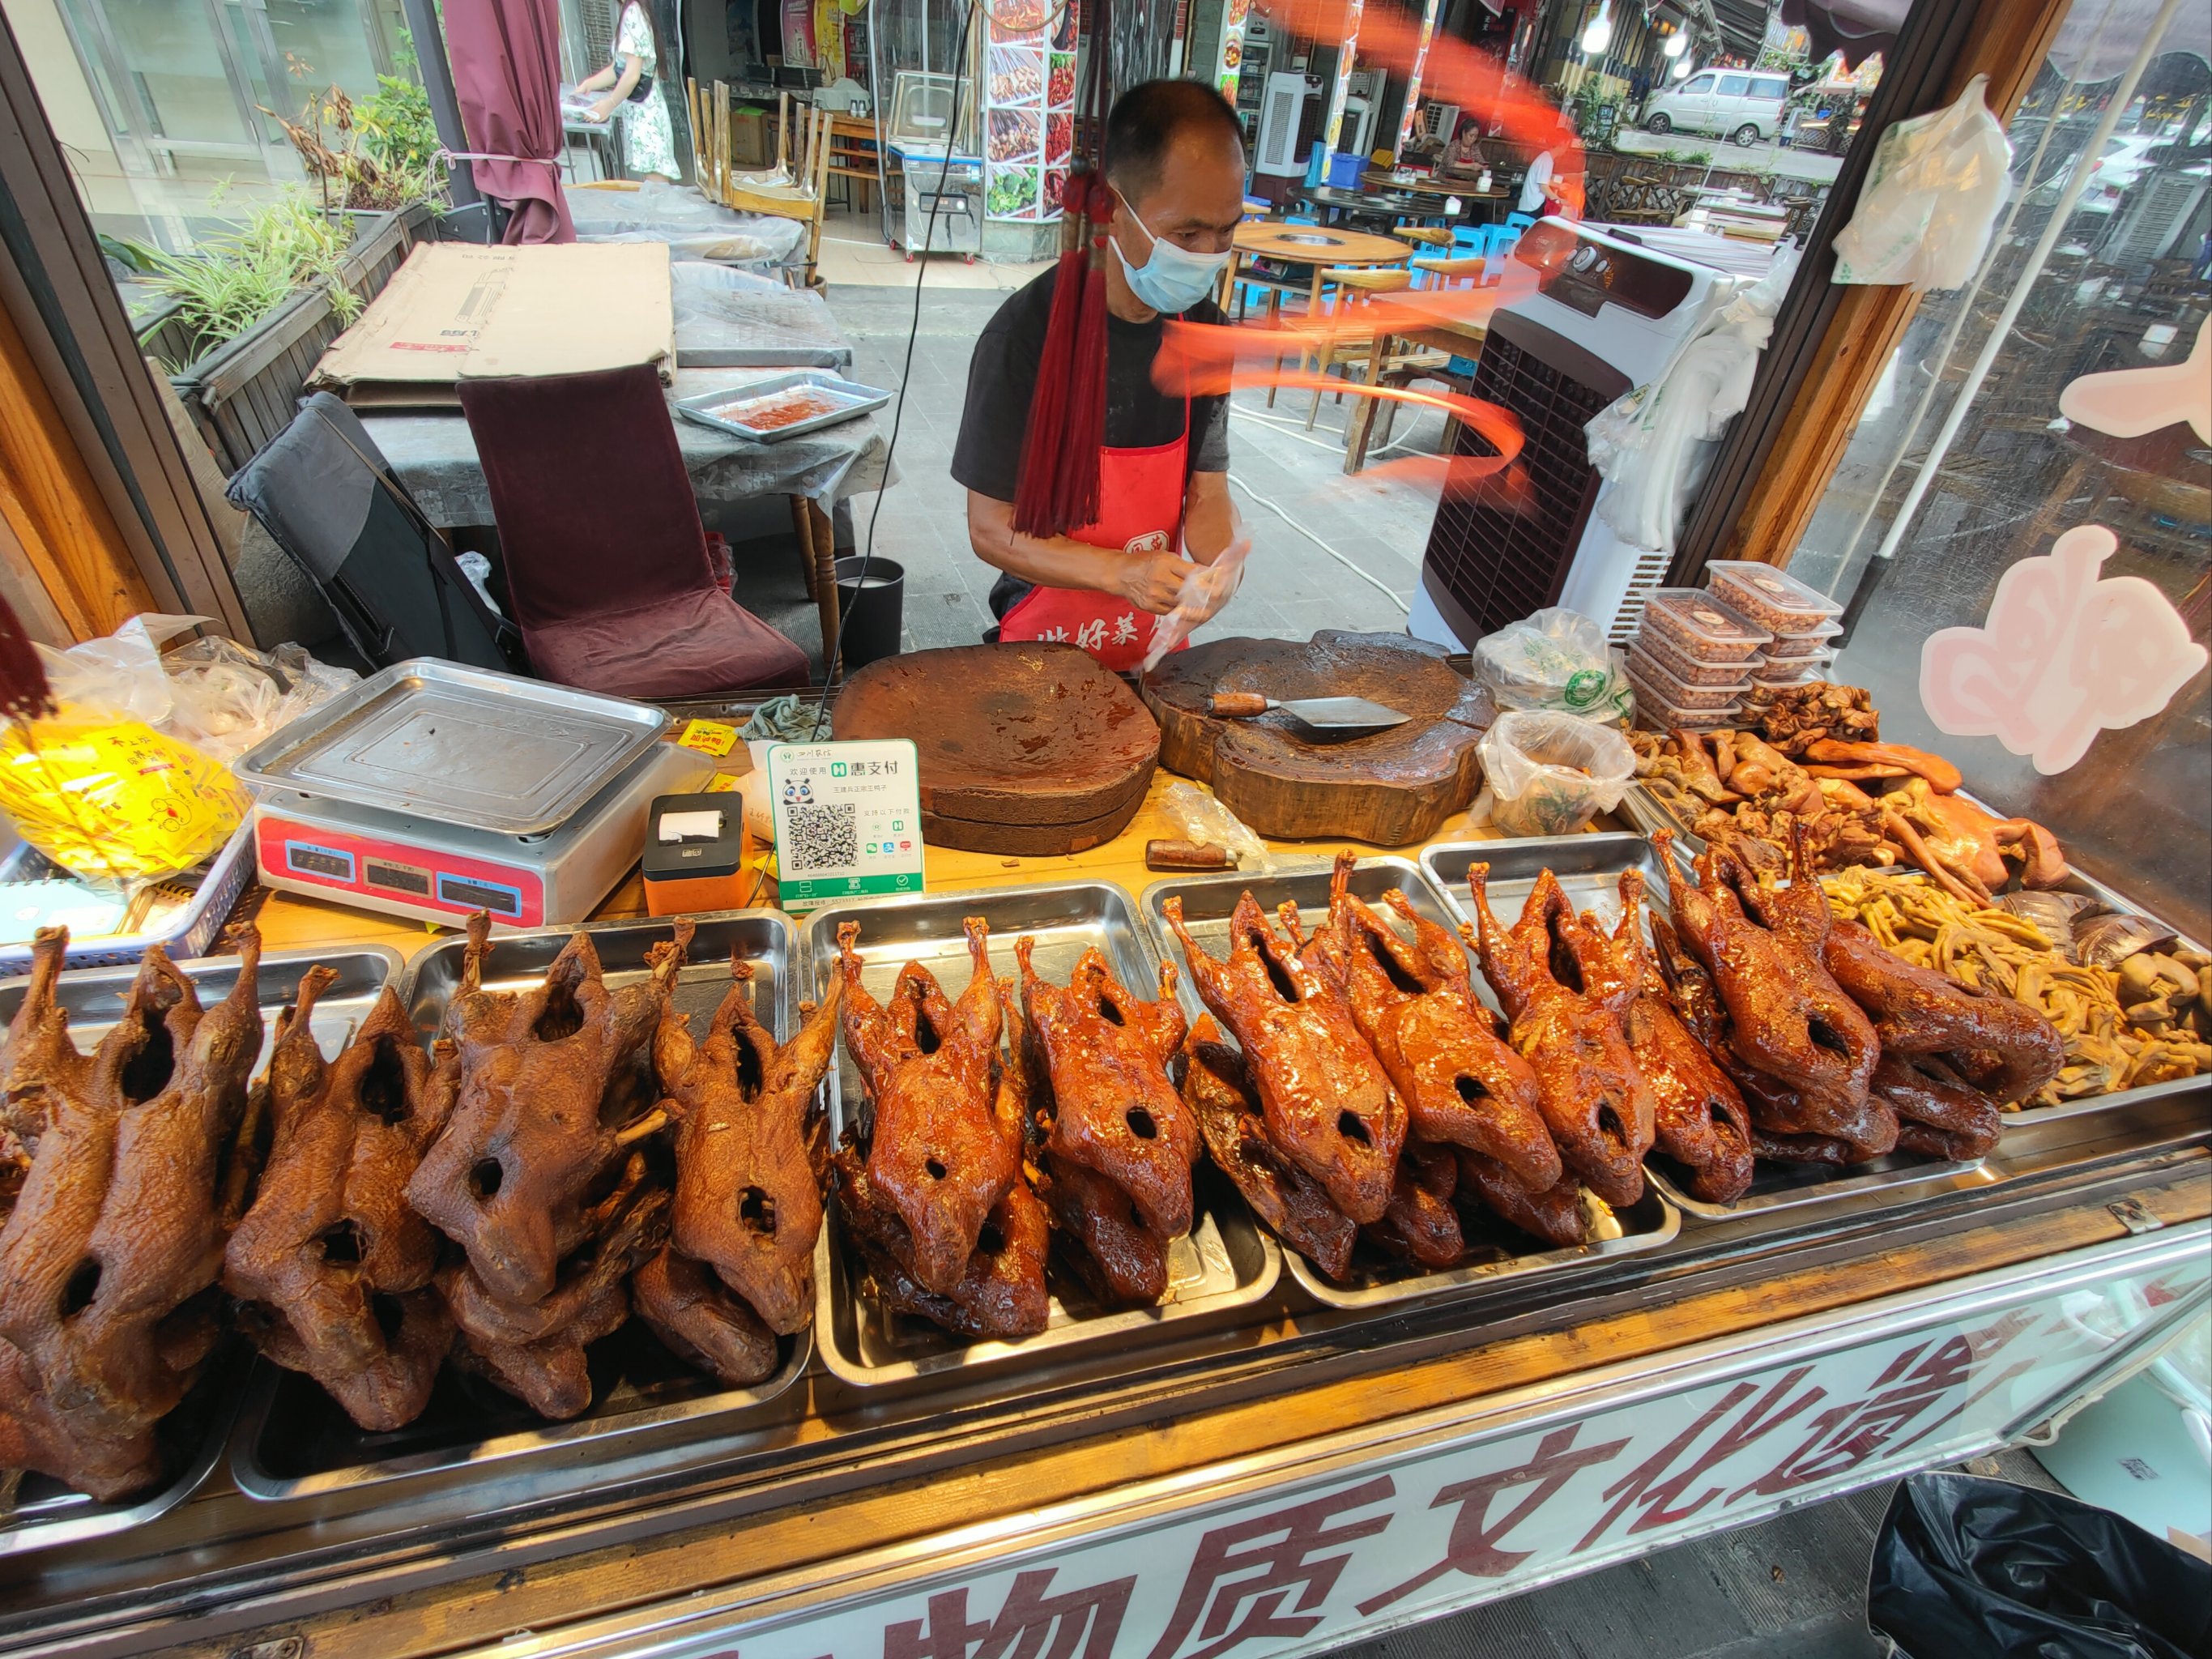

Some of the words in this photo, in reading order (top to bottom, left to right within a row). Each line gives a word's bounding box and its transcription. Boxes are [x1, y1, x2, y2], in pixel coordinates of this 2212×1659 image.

[1038, 611, 1164, 650] 好菜
[790, 767, 827, 776] 欢迎使用
[850, 760, 898, 776] 惠支付
[695, 1268, 2199, 1659] 物质文化遗
